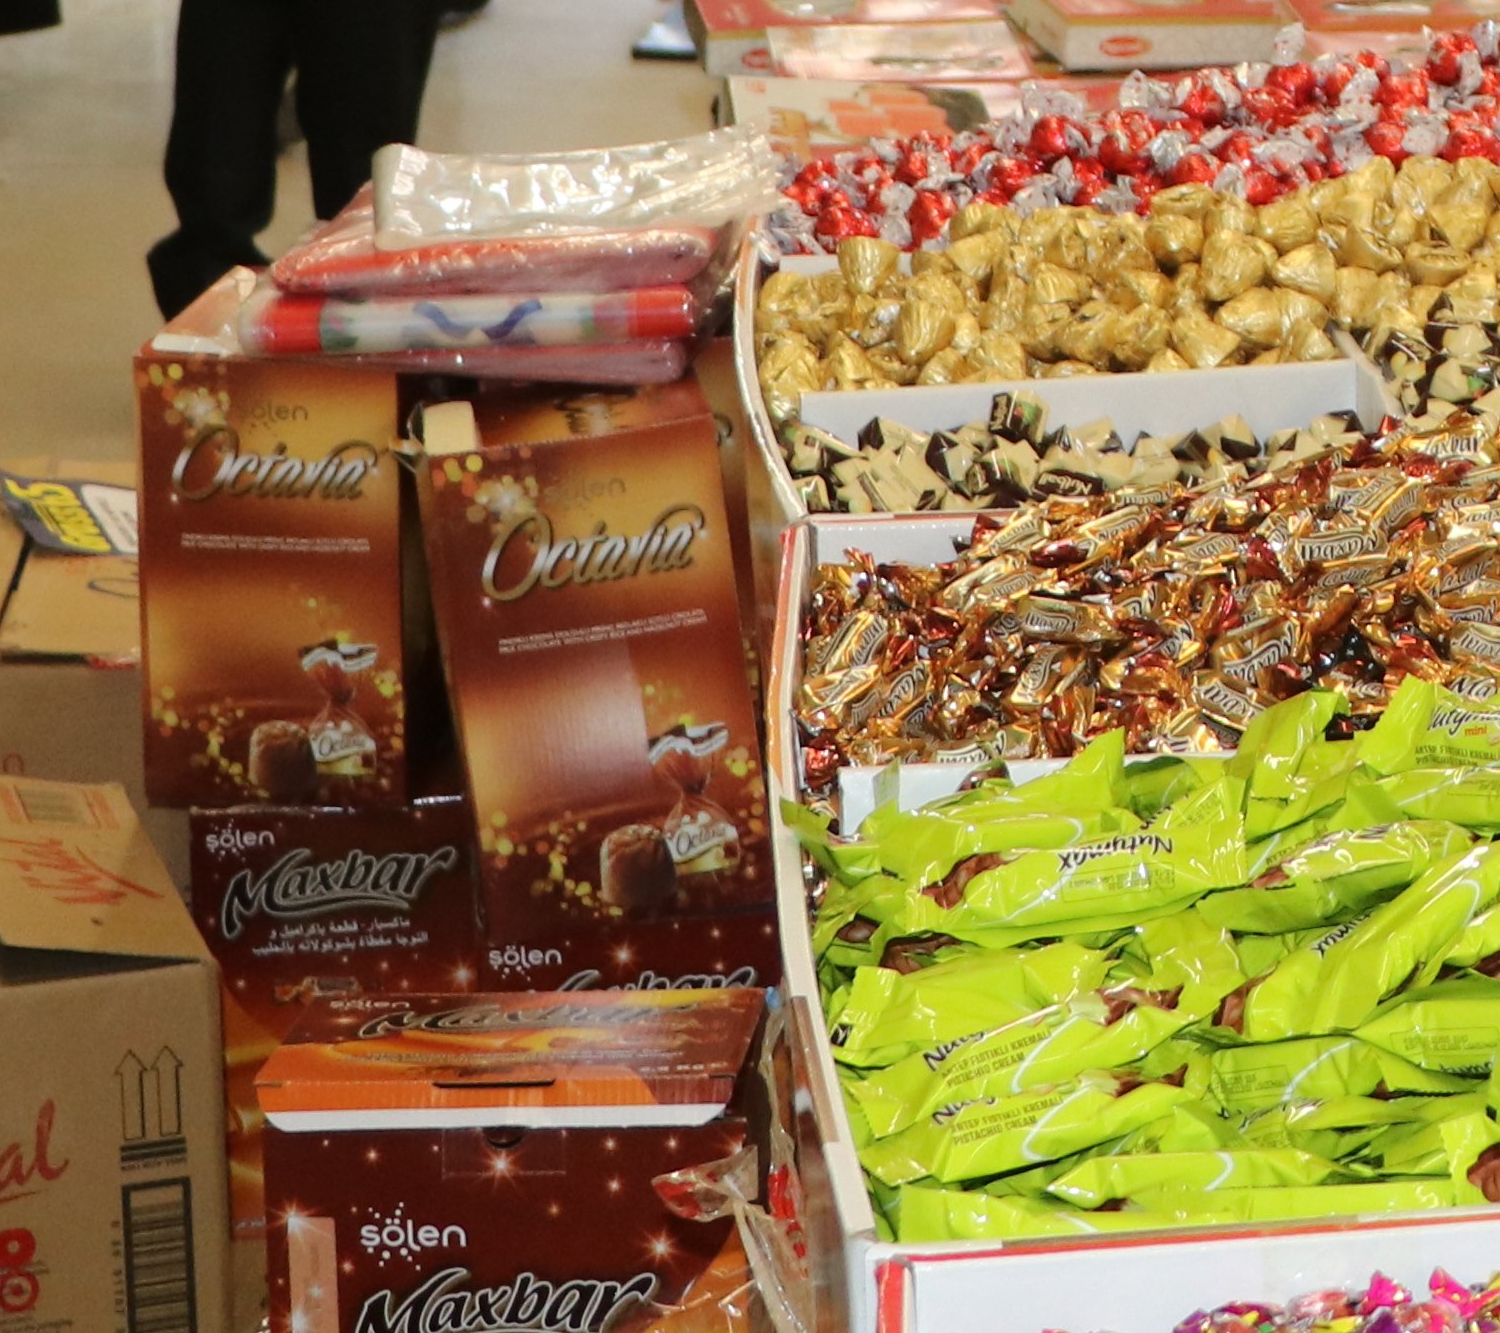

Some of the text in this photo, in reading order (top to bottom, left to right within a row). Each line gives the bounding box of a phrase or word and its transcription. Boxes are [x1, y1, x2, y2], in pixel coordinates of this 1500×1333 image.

[171, 425, 380, 502] Octavia
[482, 503, 705, 601] Octavia
[205, 823, 276, 852] şölen
[221, 844, 456, 940] Maxbar
[488, 944, 563, 977] şölen
[360, 1211, 468, 1255] şölen
